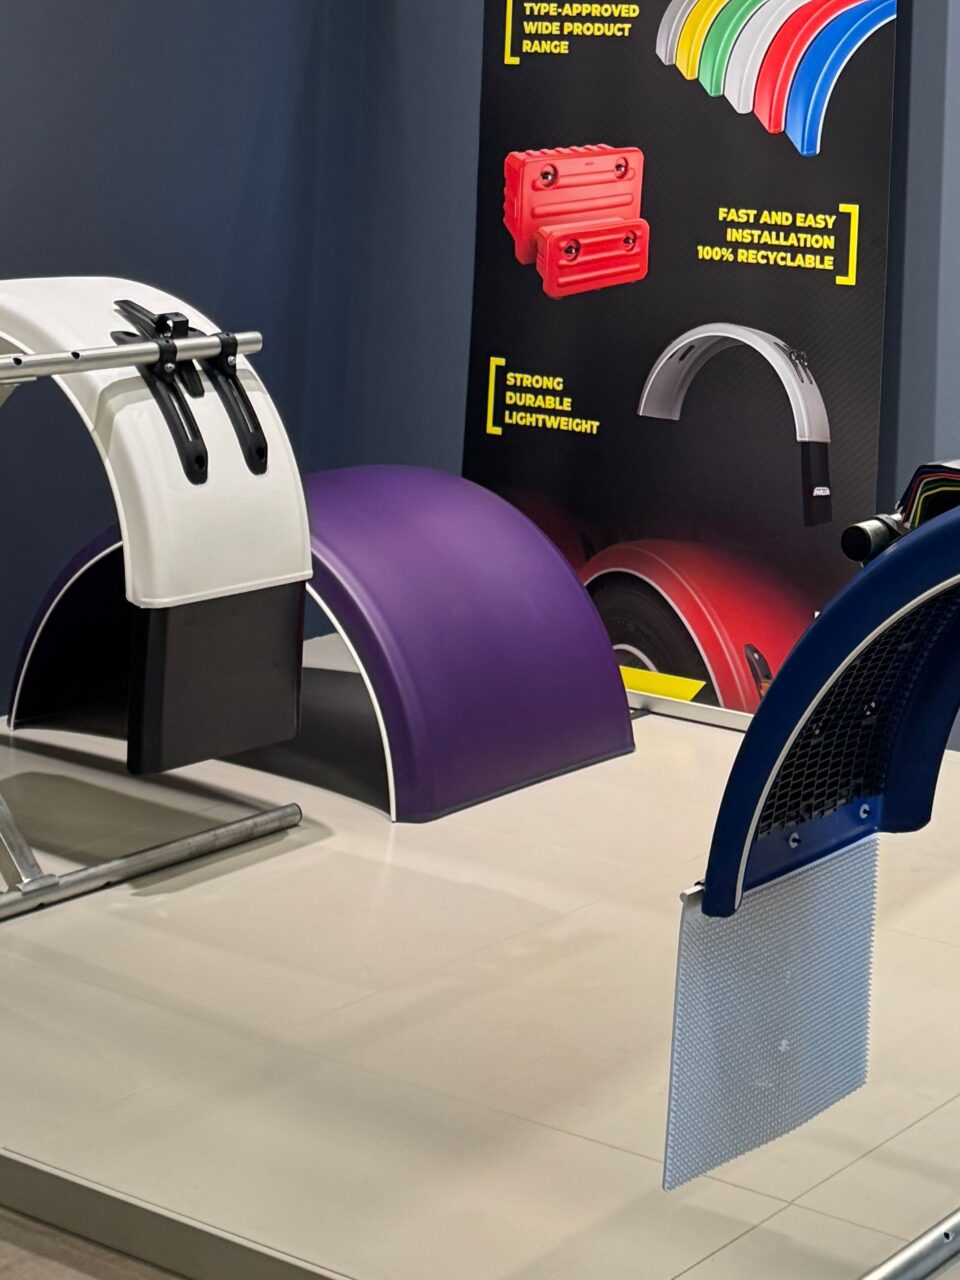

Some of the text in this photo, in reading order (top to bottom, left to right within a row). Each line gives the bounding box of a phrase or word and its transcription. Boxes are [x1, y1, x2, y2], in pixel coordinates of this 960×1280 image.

[523, 2, 640, 18] TYPE-APPROVED
[523, 21, 632, 37] WIDE PRODUCT
[522, 39, 569, 54] RANGE
[718, 207, 837, 229] FAST AND EASY
[726, 228, 835, 249] INSTALLATION
[697, 245, 834, 270] 100% RECYCLABLE
[506, 372, 564, 391] STRONG
[505, 391, 572, 411] DURABLE
[504, 410, 600, 435] LIGHTWEIGHT
